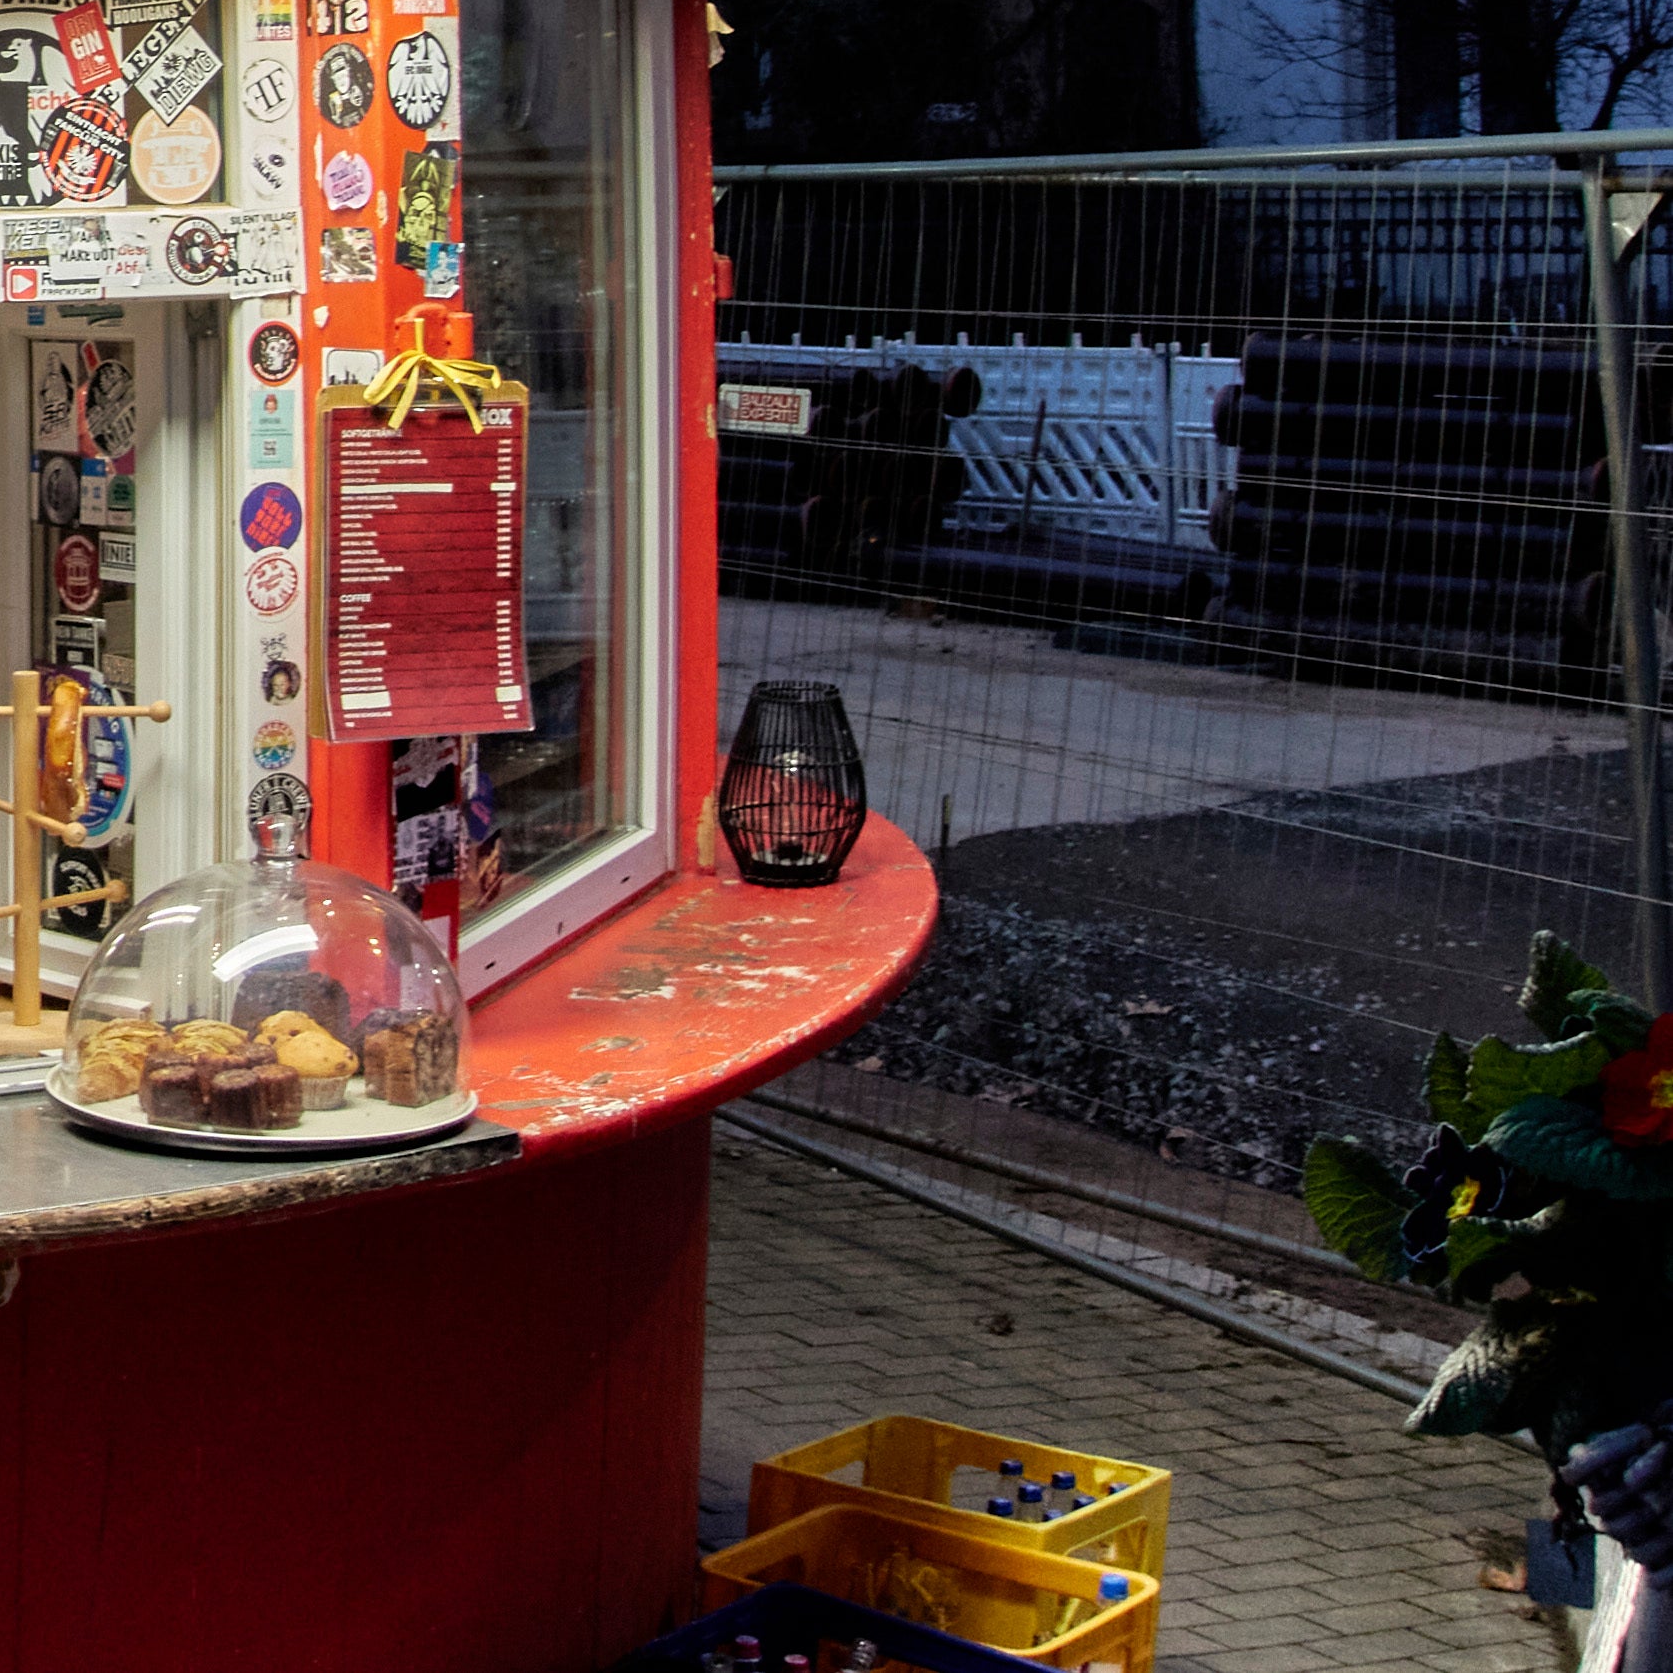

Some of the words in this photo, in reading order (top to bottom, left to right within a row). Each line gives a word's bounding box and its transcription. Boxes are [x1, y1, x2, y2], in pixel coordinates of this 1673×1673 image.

[70, 31, 105, 59] GIN
[65, 111, 124, 147] EINTRACHT
[740, 406, 799, 422] EXPERTE
[340, 593, 372, 603] COFFEE
